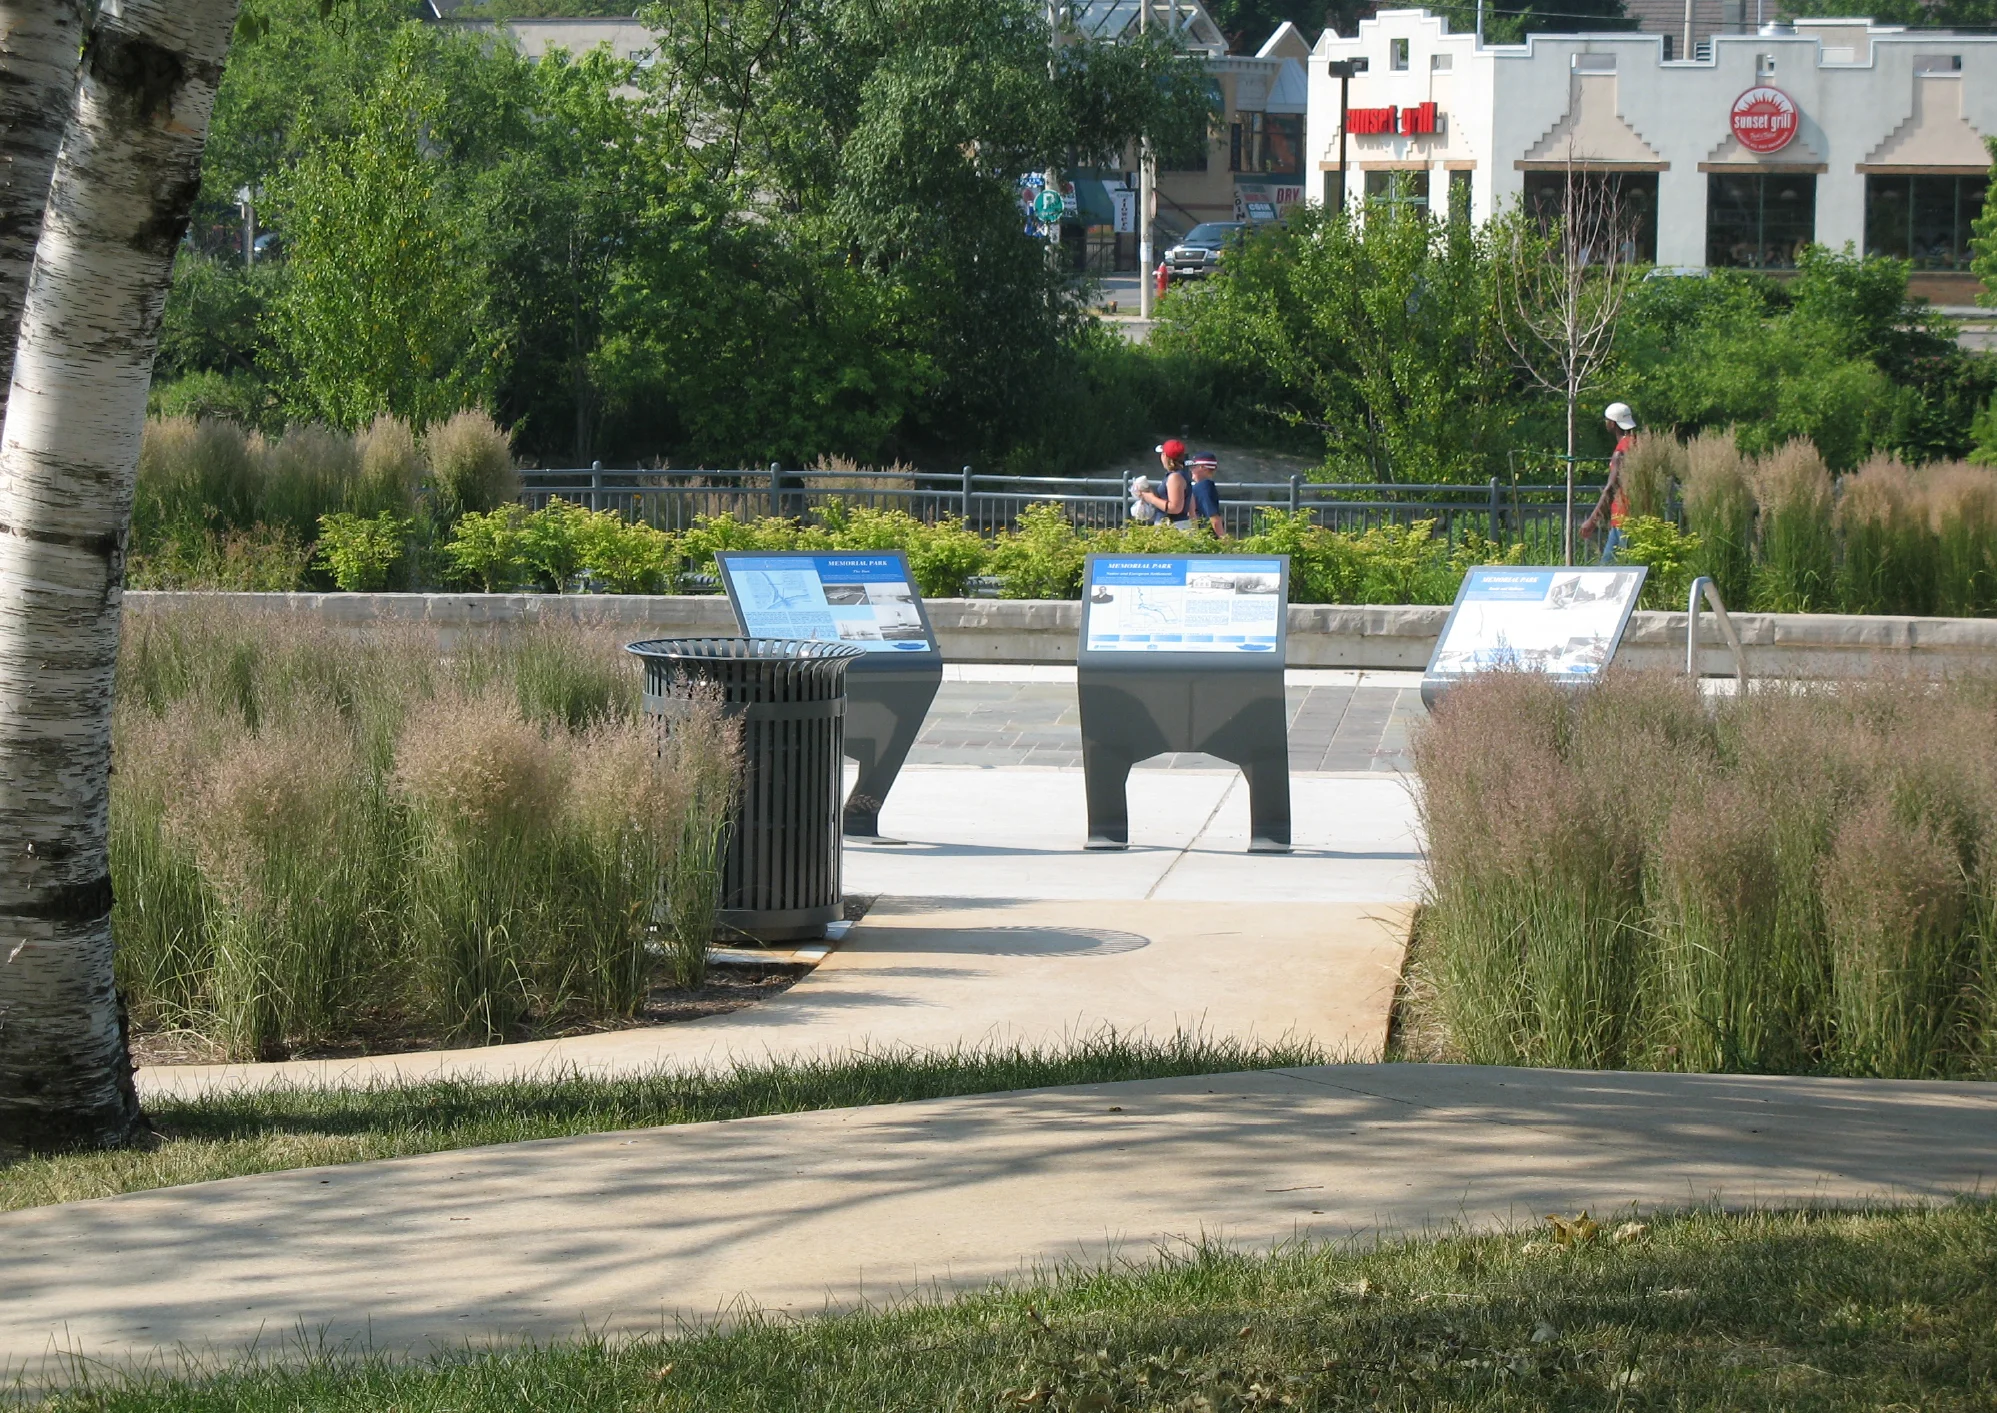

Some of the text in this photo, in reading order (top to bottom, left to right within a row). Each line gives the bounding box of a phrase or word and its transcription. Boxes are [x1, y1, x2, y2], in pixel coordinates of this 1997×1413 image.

[1402, 102, 1435, 137] grill
[1734, 113, 1791, 132] sunset grill
[1042, 193, 1055, 209] P
[1276, 188, 1300, 204] DRY
[1248, 203, 1272, 211] COIN
